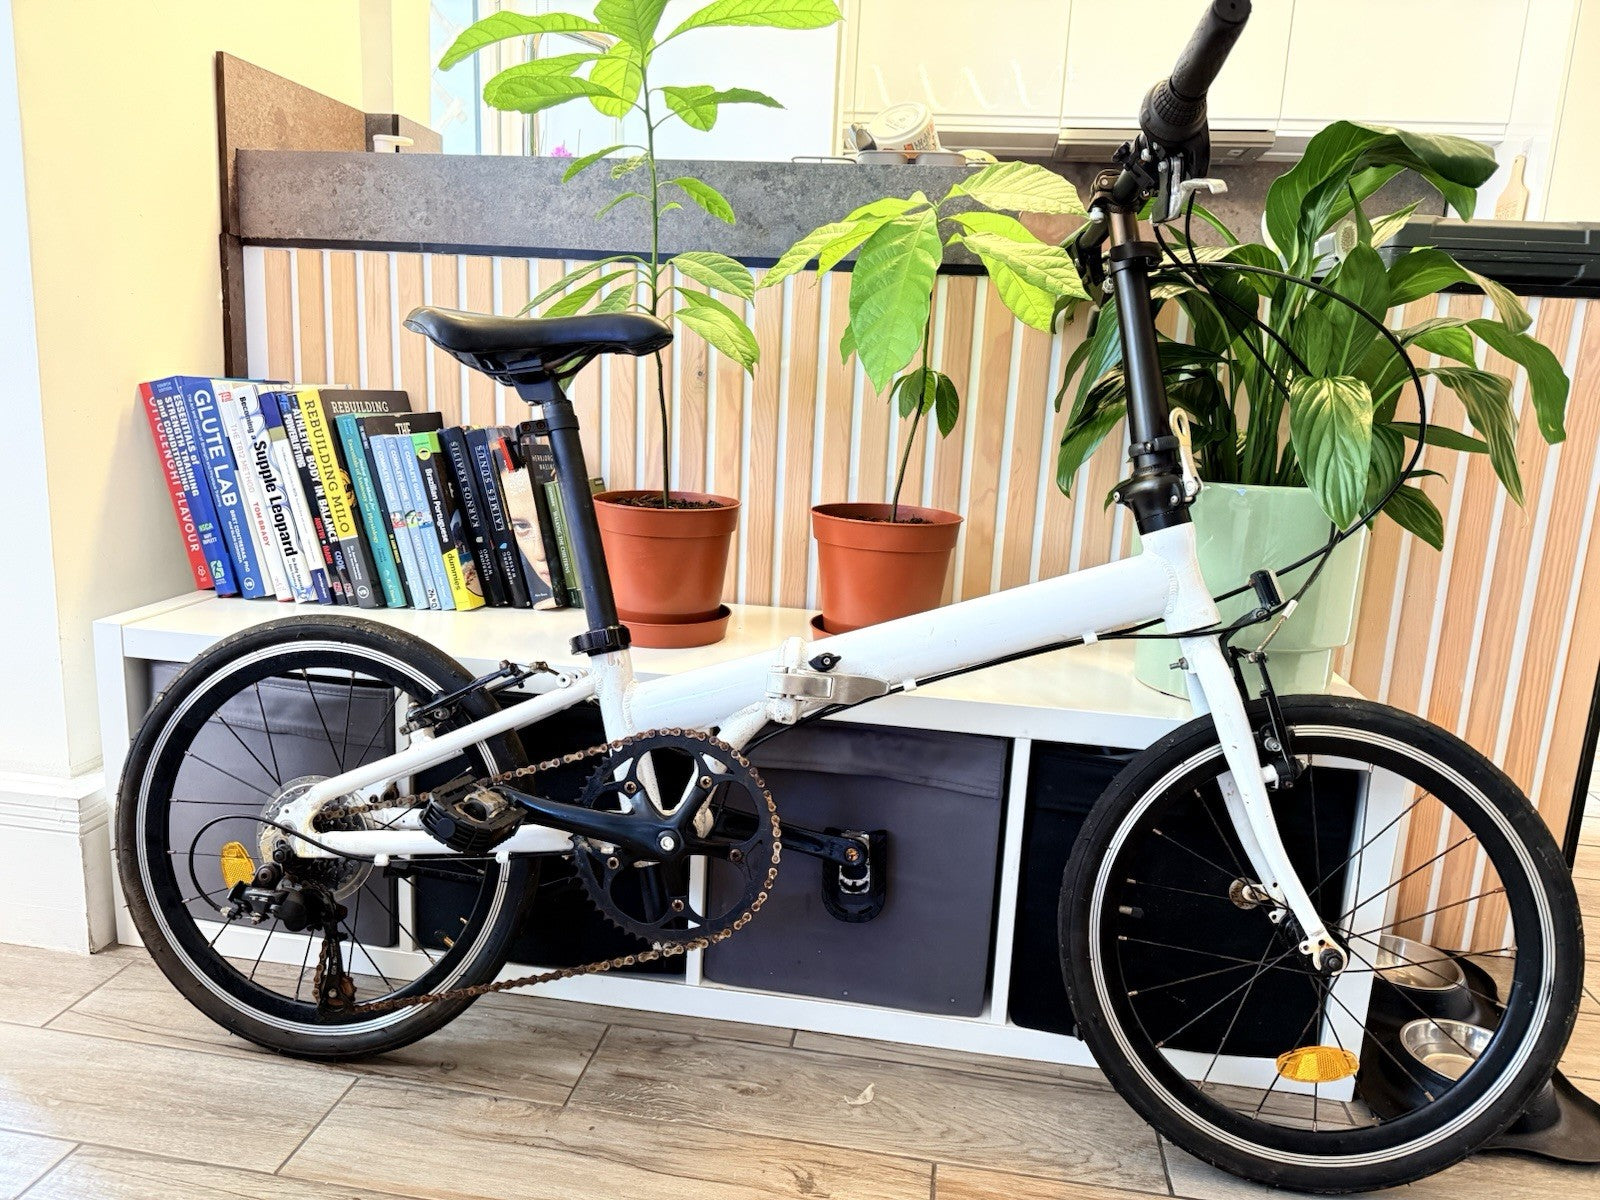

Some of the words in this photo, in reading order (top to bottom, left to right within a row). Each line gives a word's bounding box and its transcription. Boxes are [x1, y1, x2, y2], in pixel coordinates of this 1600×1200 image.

[331, 401, 389, 413] REBUILDING
[395, 422, 411, 434] THE
[156, 398, 168, 418] and
[164, 420, 190, 492] CONDITIONING
[164, 396, 185, 447] STRENGTH
[180, 449, 200, 497] TRAINING
[173, 394, 196, 452] ESSENTIALS
[190, 454, 200, 466] of
[192, 388, 227, 460] GLUTE
[213, 463, 240, 508] LAB
[230, 424, 240, 439] THE
[235, 441, 246, 459] TB12
[283, 413, 307, 468] POWERLIFTING
[291, 407, 313, 453] ATHLETIC
[238, 396, 256, 433] Becoming
[250, 440, 279, 494] Supple
[267, 495, 298, 558] Leopard
[240, 459, 256, 493] METHOD
[303, 399, 340, 492] REBUILDING
[331, 494, 352, 533] MILO
[305, 454, 321, 482] BODY
[377, 450, 390, 481] COMPLETE
[386, 482, 396, 501] GUIDE
[390, 449, 403, 480] COMPLETE
[399, 481, 409, 501] GUIDE
[404, 451, 417, 483] COMPLETE
[413, 482, 423, 502] GUIDE
[424, 467, 440, 500] Brazilian
[313, 484, 324, 497] IN
[462, 486, 480, 528] KARNOS
[175, 491, 201, 552] FLAVOUR
[229, 510, 238, 525] BRET
[253, 502, 262, 519] TOM
[258, 520, 270, 547] BRADY
[314, 516, 326, 540] AUSTIN
[317, 498, 339, 544] BALANCE
[431, 500, 451, 544] Portuguese
[552, 510, 562, 536] WALKING
[334, 550, 346, 571] COOK
[446, 553, 463, 591] dummies
